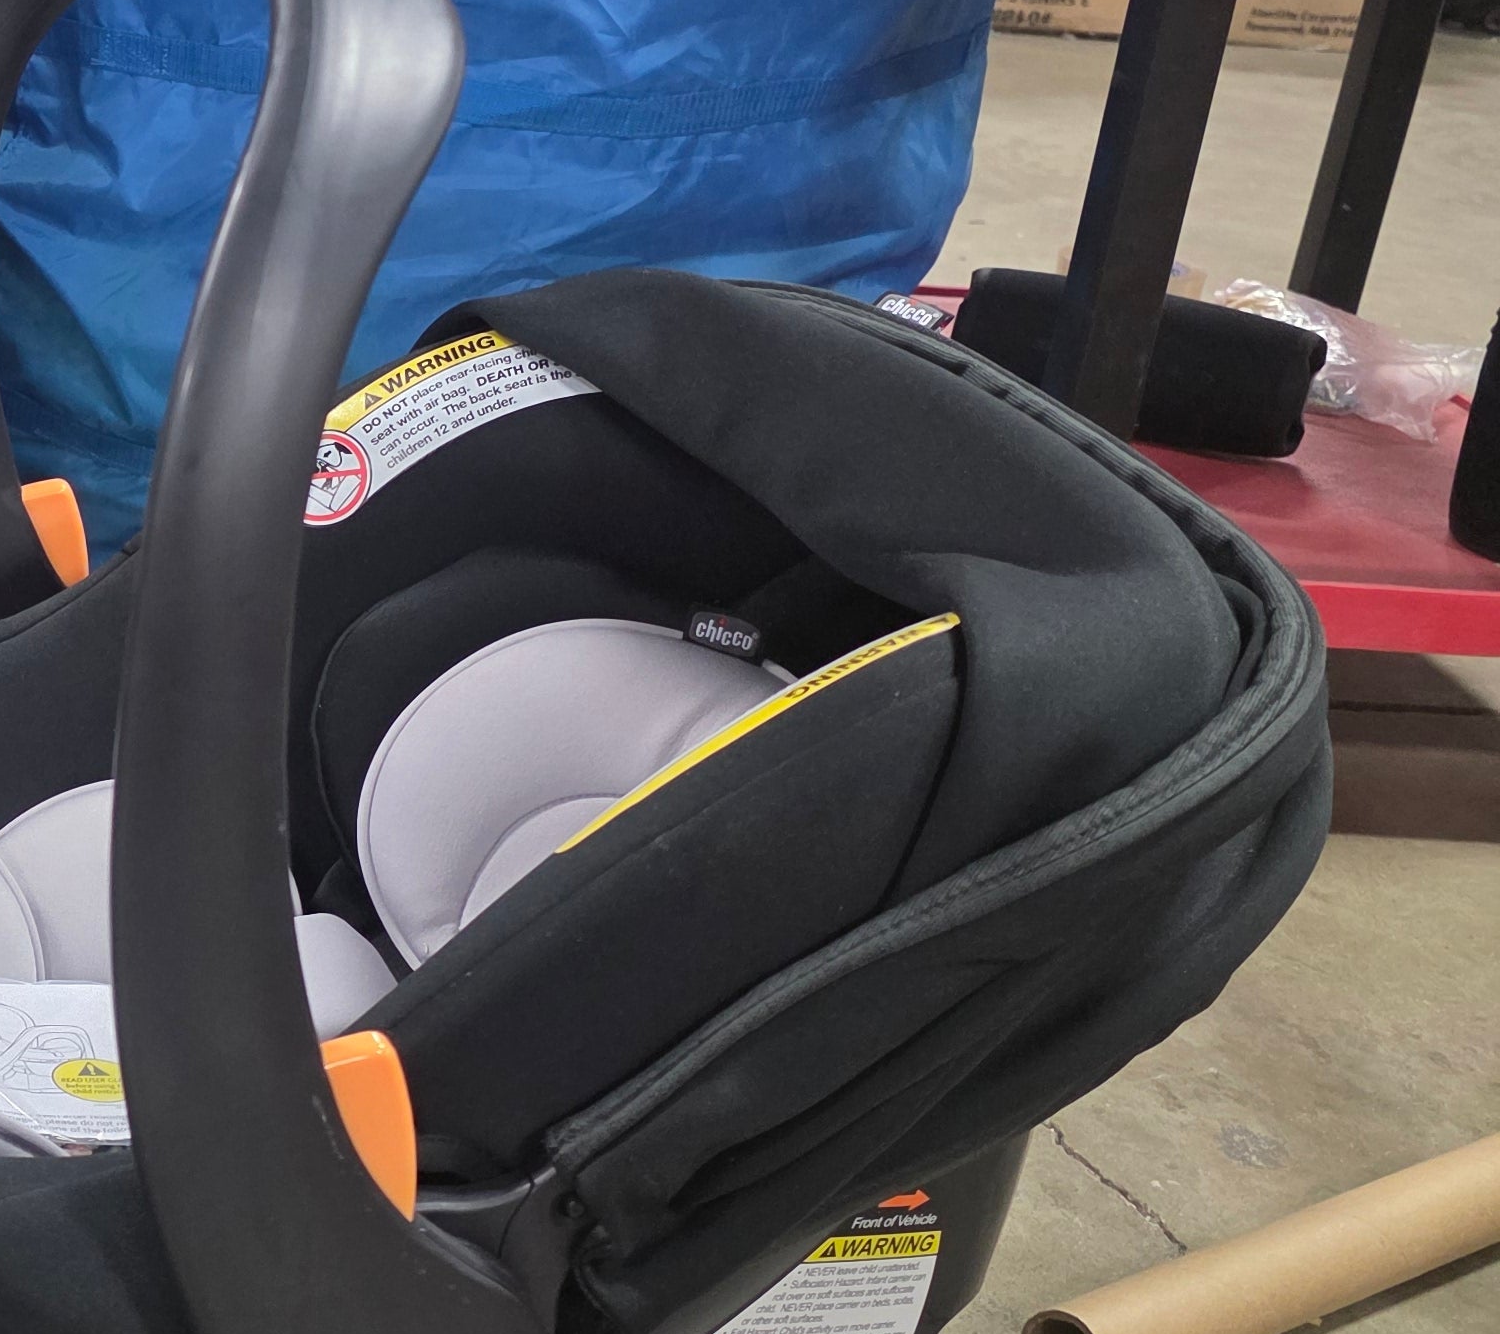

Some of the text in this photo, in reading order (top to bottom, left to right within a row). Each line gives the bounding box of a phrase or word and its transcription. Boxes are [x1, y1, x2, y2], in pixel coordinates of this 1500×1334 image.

[881, 298, 934, 326] chicco
[379, 335, 496, 394] WARNING
[362, 354, 512, 434] DO NOT place rear-facing
[370, 359, 550, 446] seat with air bag. DEATH OR
[379, 369, 573, 457] can occur. The back seat is the
[387, 394, 518, 469] children 12 and under.
[695, 615, 754, 651] chicco
[785, 626, 928, 700] WARNING
[851, 1213, 938, 1230] Front of Vehicle
[841, 1233, 935, 1257] WARNING
[790, 1279, 833, 1289] Suffocation
[804, 1265, 875, 1277] NEVER child
[780, 1301, 833, 1313] NEVER place
[833, 1289, 865, 1299] surfaces
[789, 1314, 823, 1323] surfaces.
